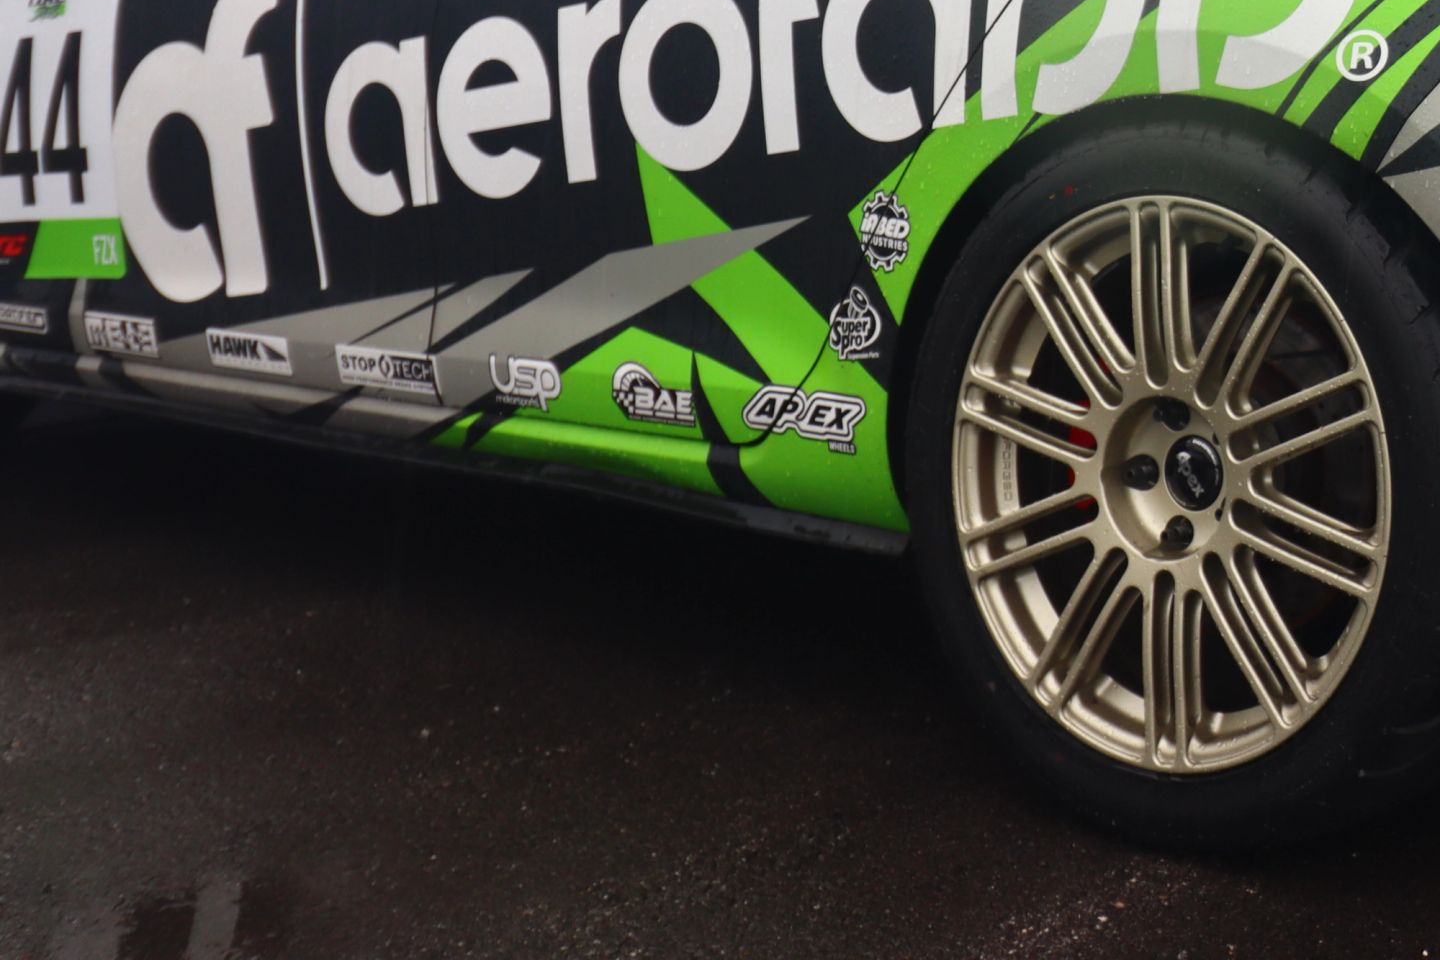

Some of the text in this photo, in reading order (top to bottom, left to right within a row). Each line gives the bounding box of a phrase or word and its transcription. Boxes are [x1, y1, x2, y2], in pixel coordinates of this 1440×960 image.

[831, 318, 868, 347] Super
[209, 335, 262, 361] HAWK
[634, 386, 693, 415] BAE
[754, 396, 853, 431] APEX
[828, 441, 855, 454] WHEELS
